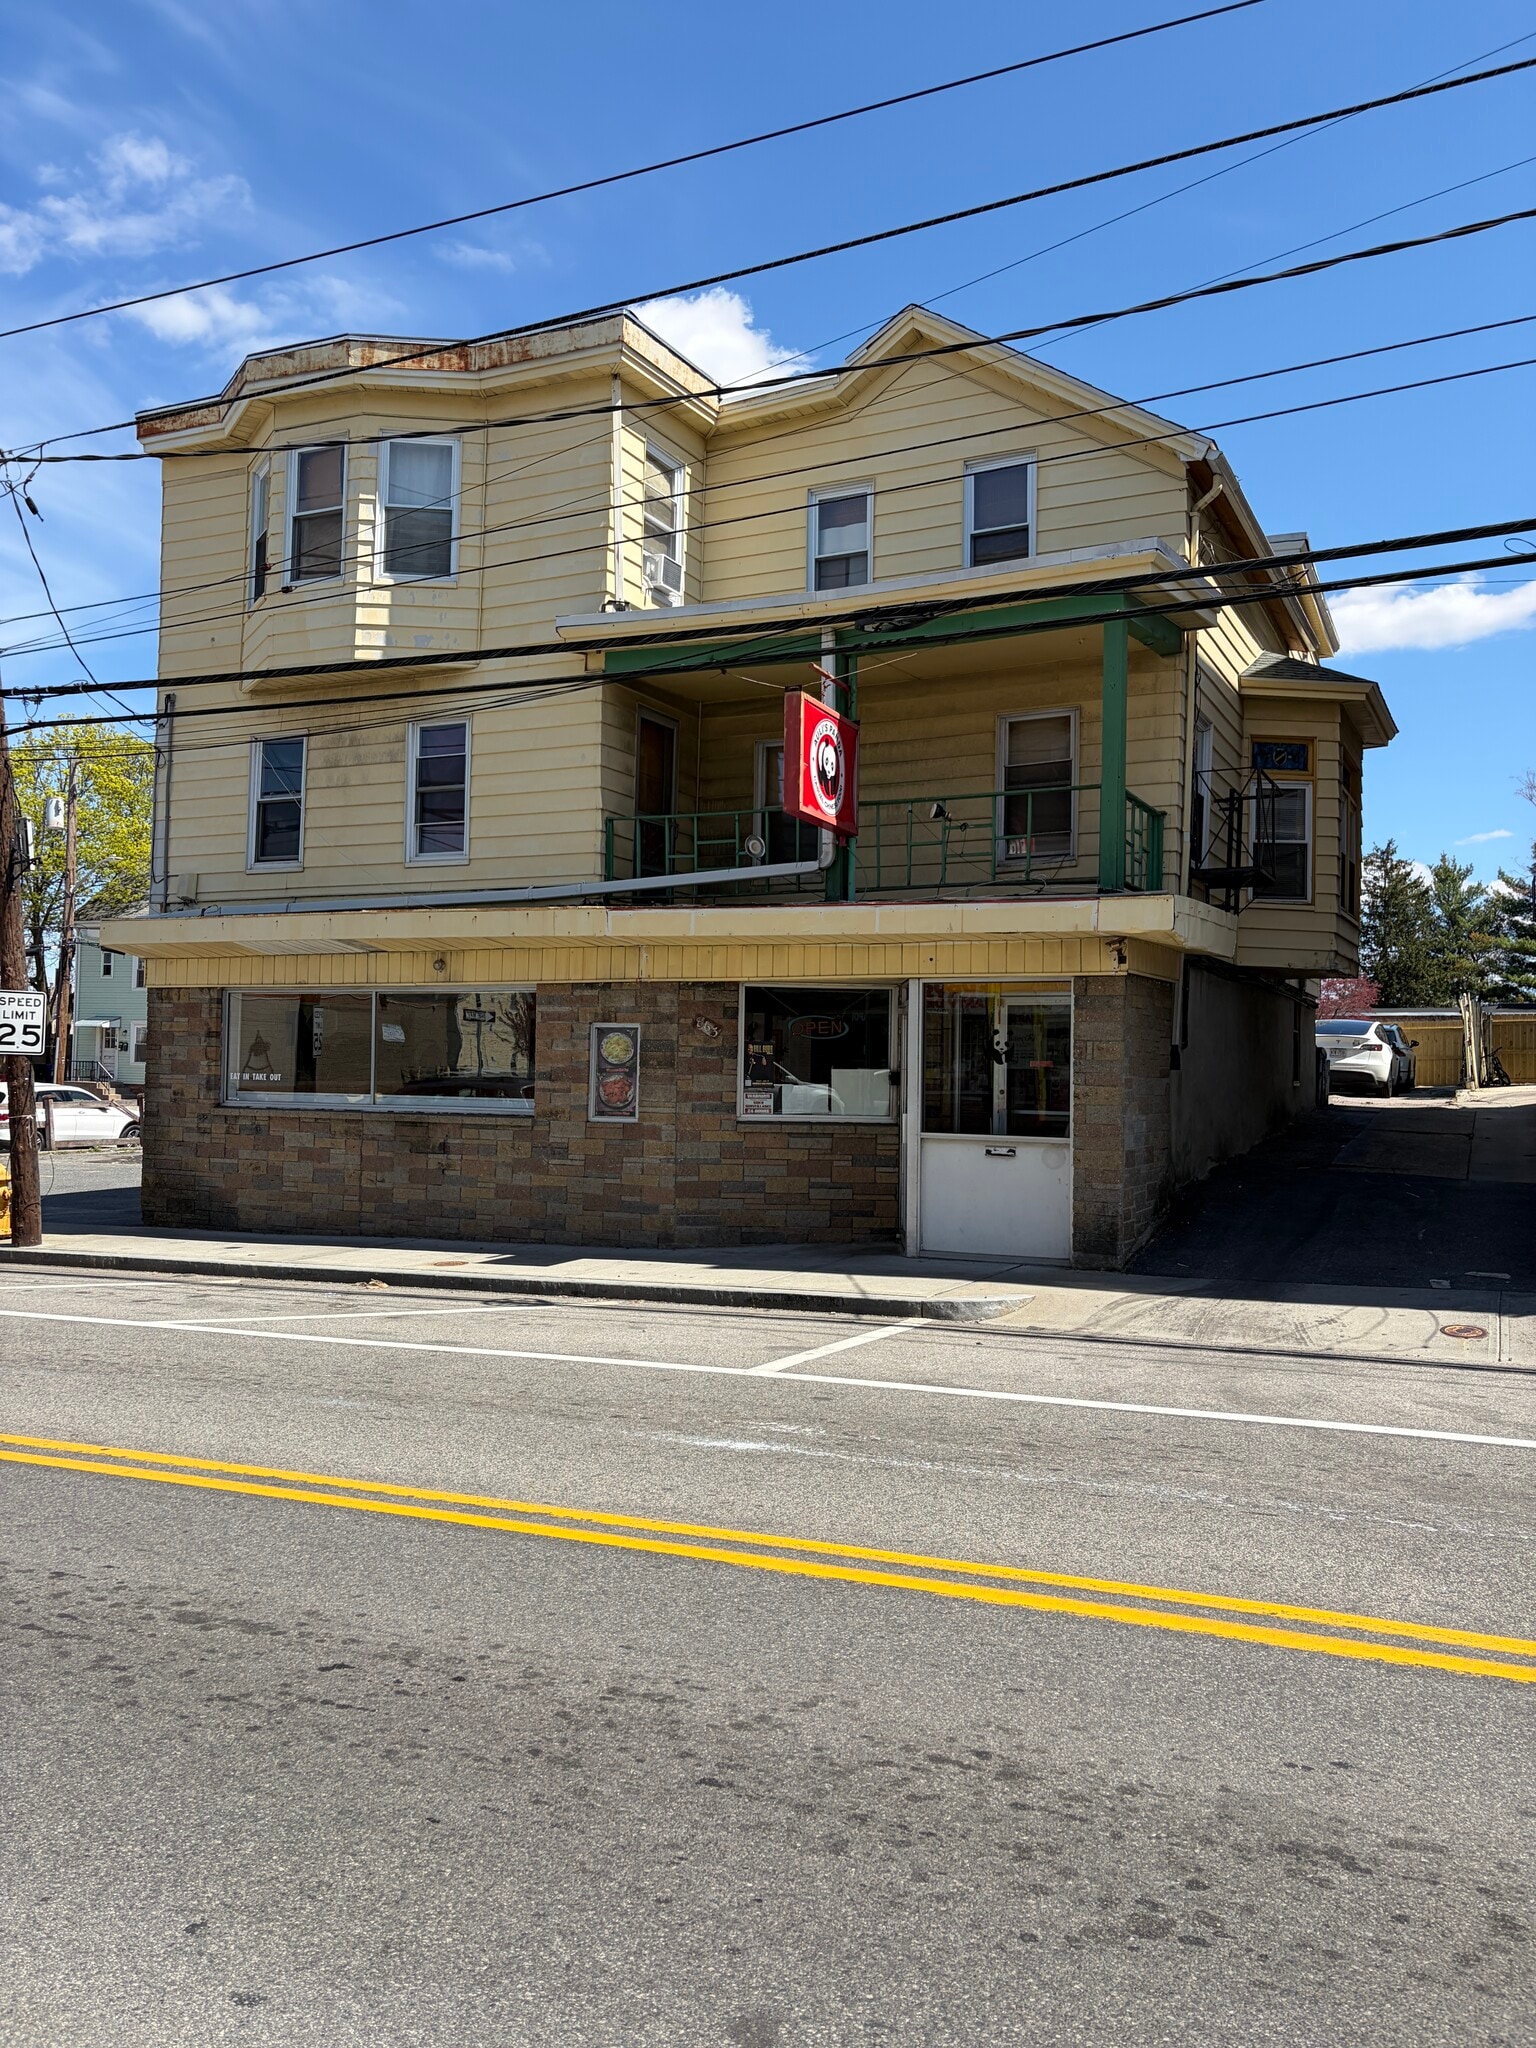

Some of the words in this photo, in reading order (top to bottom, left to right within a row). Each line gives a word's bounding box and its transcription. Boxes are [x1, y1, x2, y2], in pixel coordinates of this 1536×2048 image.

[830, 726, 842, 756] PANDA
[0, 997, 41, 1008] SPEED
[2, 1010, 36, 1020] LIMIT
[792, 1020, 842, 1034] OPEN
[0, 1023, 41, 1046] 25
